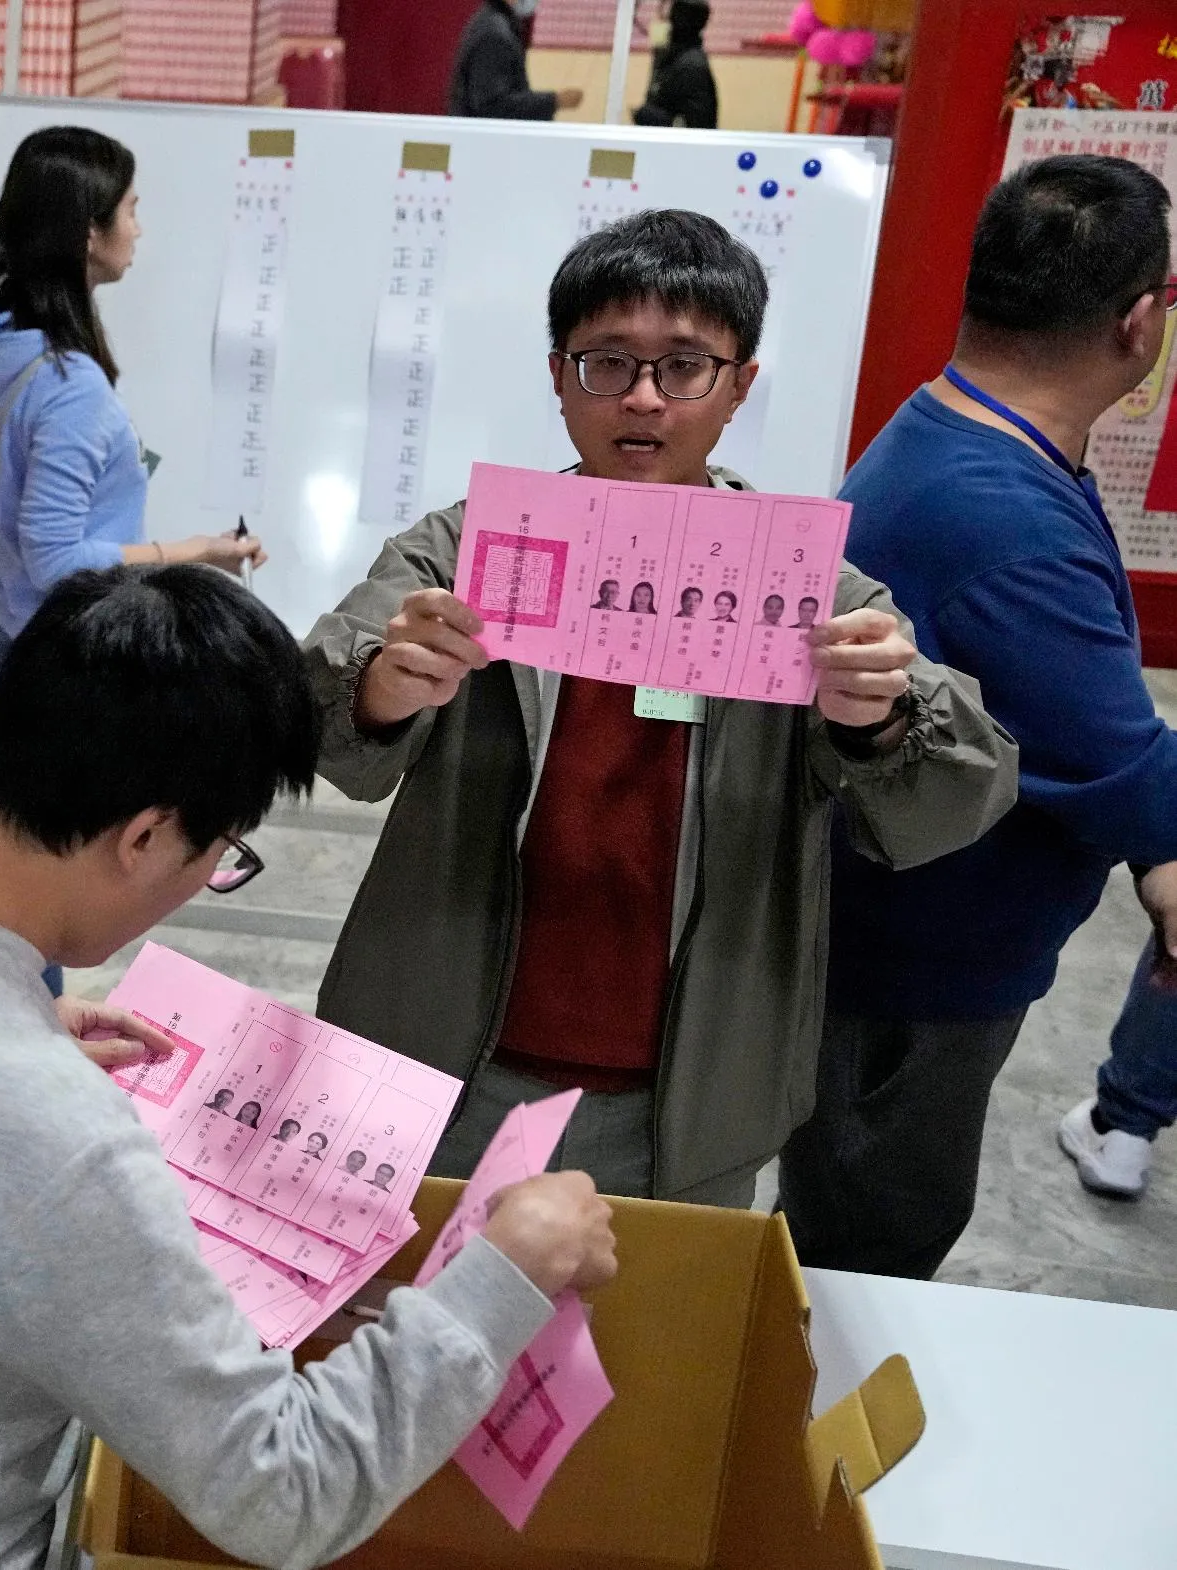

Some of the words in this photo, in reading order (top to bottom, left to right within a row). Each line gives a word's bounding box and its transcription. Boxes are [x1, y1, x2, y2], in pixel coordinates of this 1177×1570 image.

[630, 534, 638, 549] 1
[709, 541, 723, 557] 2
[792, 548, 805, 564] 3
[254, 1062, 265, 1075] 1
[316, 1091, 331, 1106] 2
[383, 1123, 397, 1137] 3
